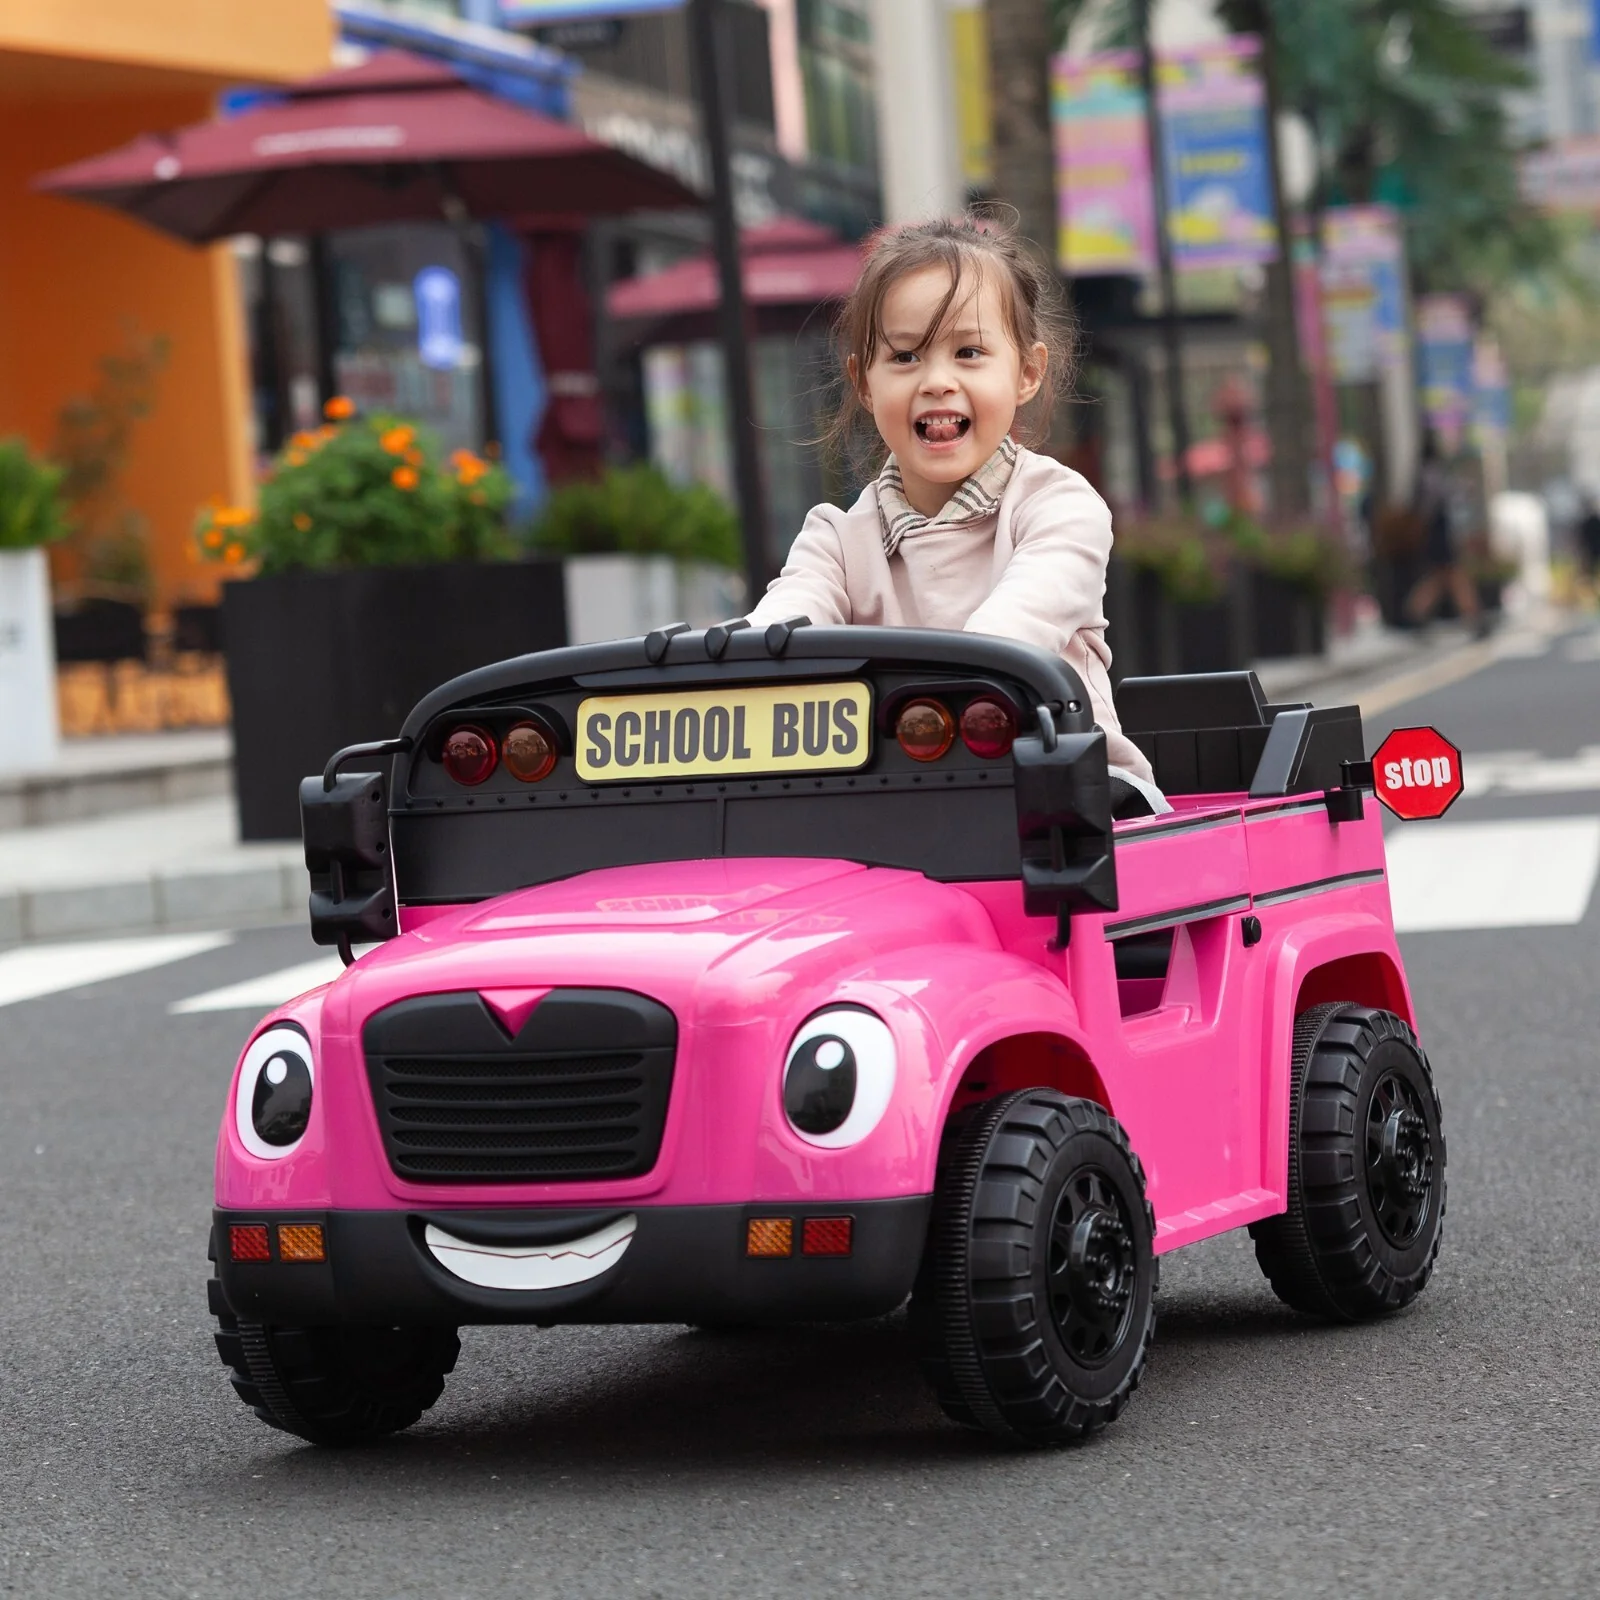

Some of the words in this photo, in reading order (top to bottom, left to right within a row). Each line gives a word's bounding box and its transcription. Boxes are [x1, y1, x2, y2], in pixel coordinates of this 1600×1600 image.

[586, 706, 752, 768] SCHOOL
[772, 698, 858, 758] BUS
[1384, 756, 1452, 790] stop
